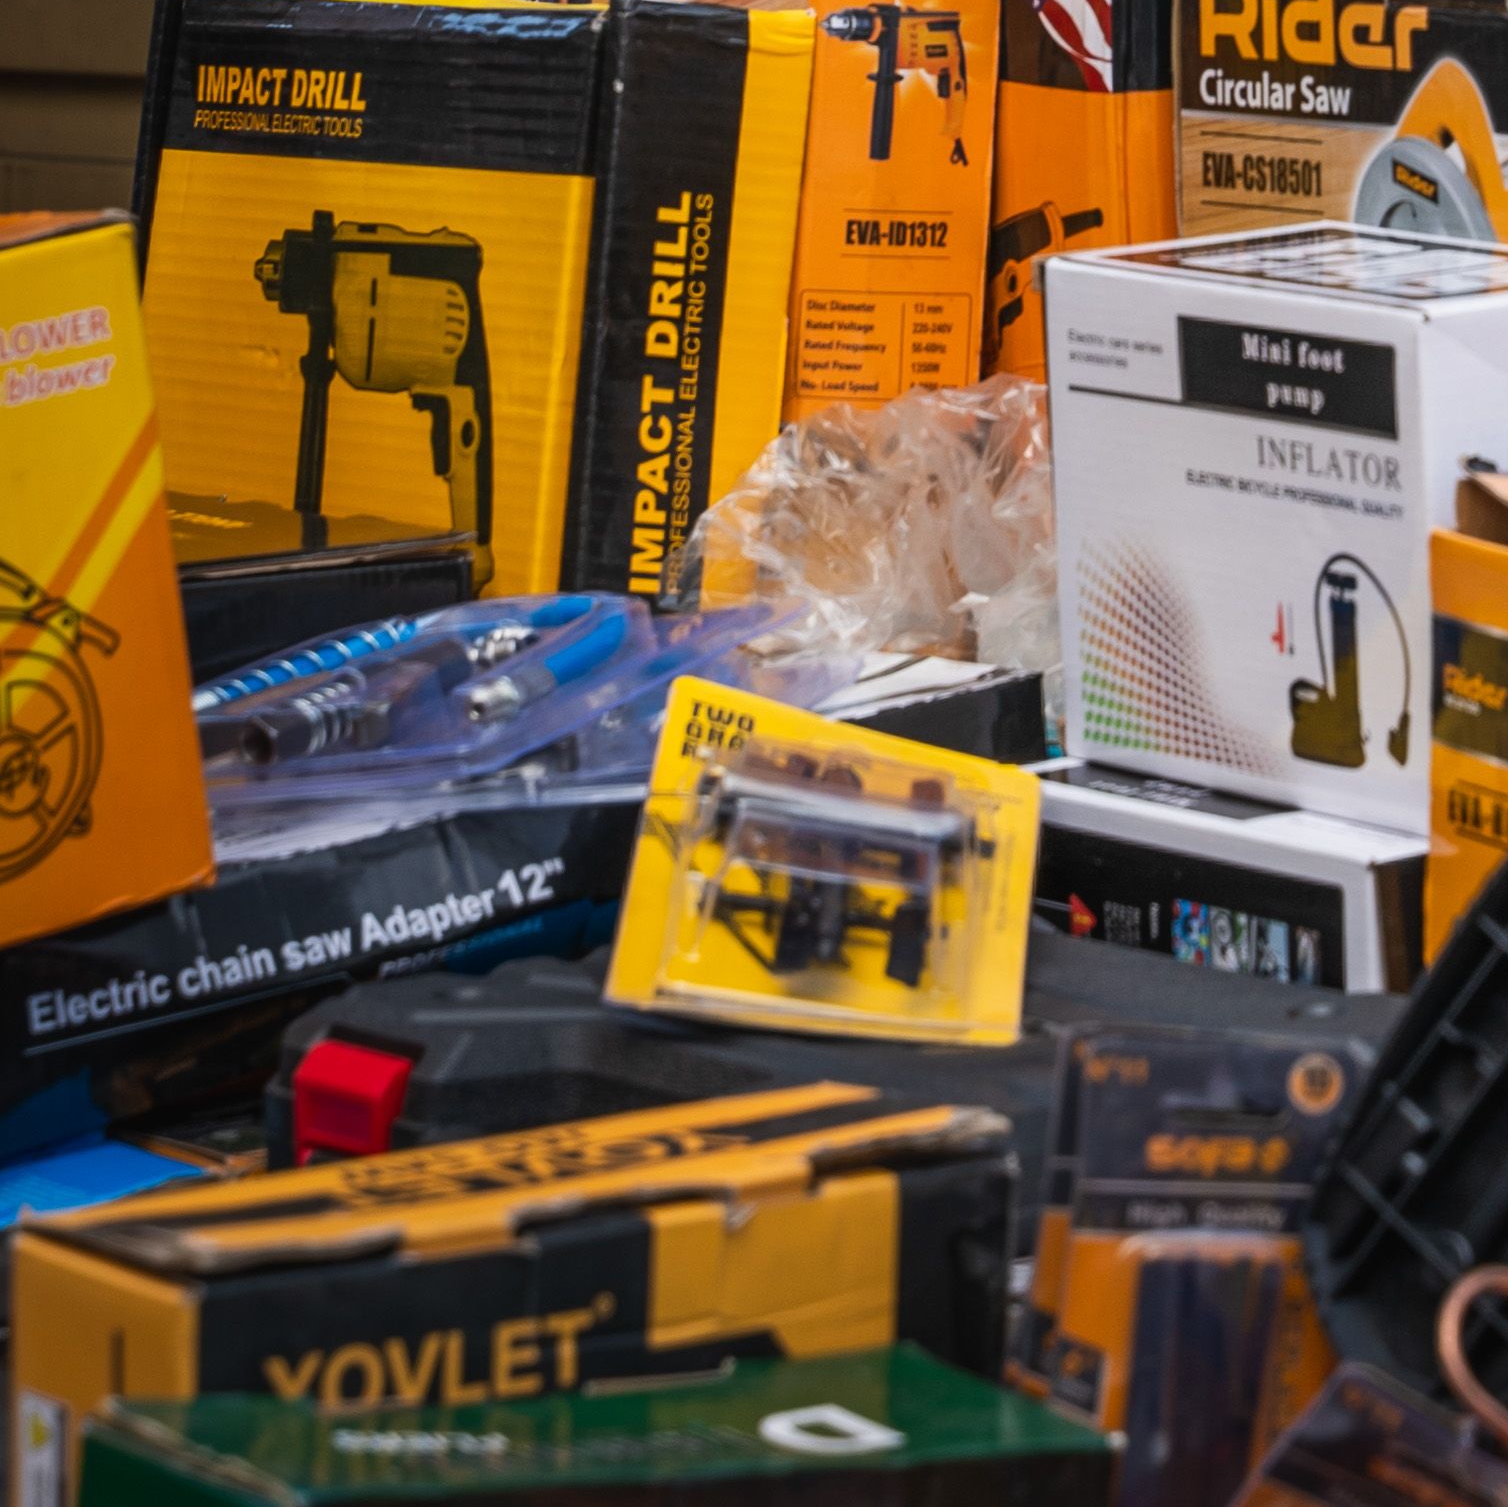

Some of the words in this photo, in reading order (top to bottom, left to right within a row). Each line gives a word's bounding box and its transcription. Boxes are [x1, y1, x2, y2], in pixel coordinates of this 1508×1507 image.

[197, 64, 287, 107] IMPACT
[290, 68, 367, 112] DRILL
[1200, 68, 1293, 112] Circular
[1299, 76, 1352, 116] Saw
[193, 109, 270, 133] PROFESSIONAL
[272, 113, 322, 136] ELECTRIC
[324, 116, 363, 139] TOOLS
[1201, 150, 1323, 198] EVA-CS18501
[690, 192, 714, 275] TOOLS
[845, 219, 948, 247] EVA-ID1312
[644, 191, 692, 359] DRILL
[679, 279, 706, 400] ELECTRIC
[1241, 333, 1292, 367] Mini
[1297, 340, 1346, 375] foot
[1266, 382, 1325, 415] pump
[628, 374, 675, 596] IMPACT
[1256, 436, 1402, 491] INFLATOR
[26, 972, 171, 1035] Electric
[177, 944, 276, 999] chain
[286, 926, 352, 968] saw
[360, 886, 497, 953] Adapter
[498, 856, 566, 908] 12"
